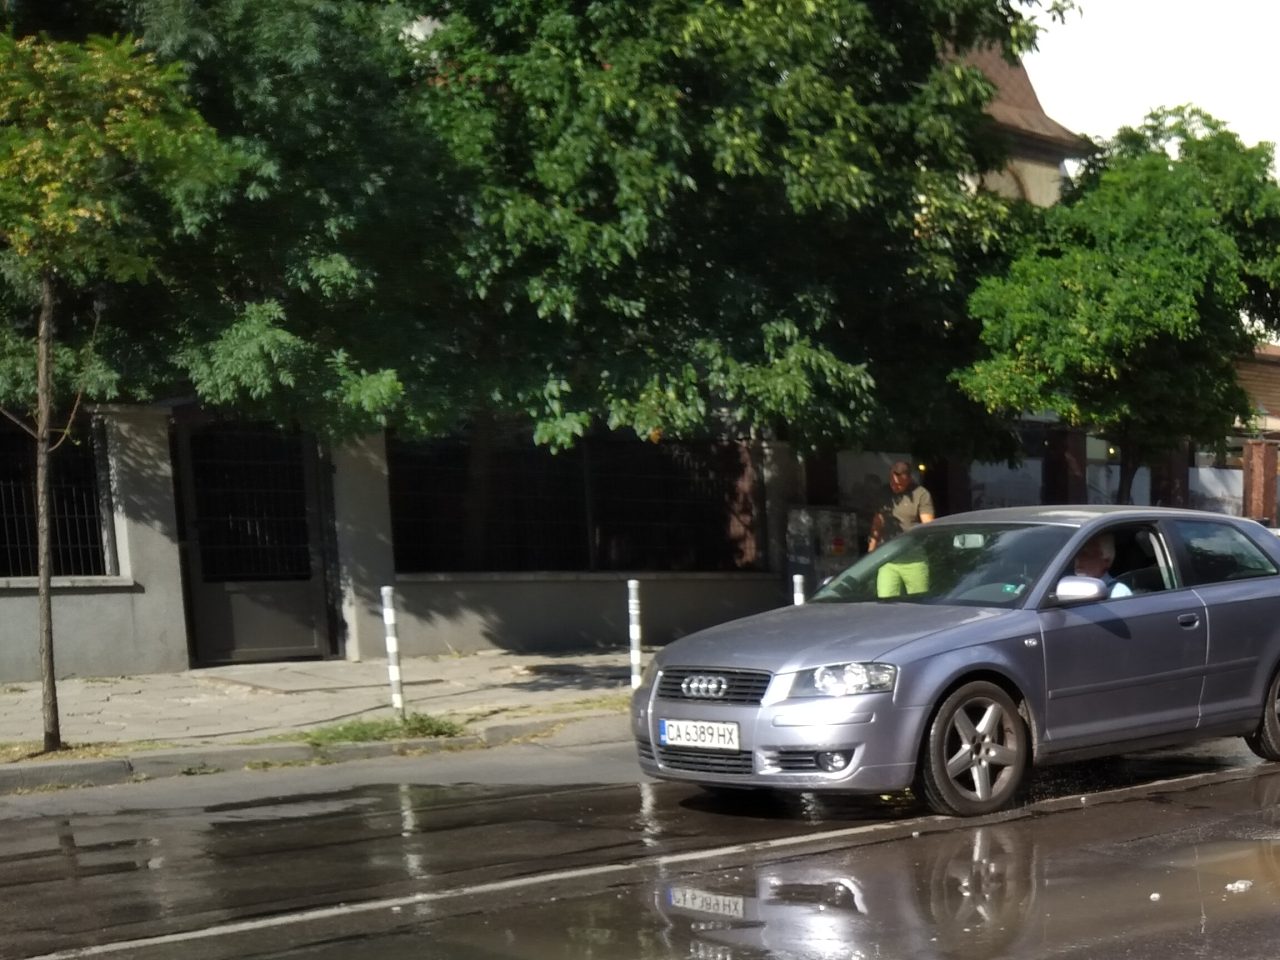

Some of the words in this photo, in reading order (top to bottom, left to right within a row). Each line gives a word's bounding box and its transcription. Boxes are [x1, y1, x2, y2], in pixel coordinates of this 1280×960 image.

[667, 724, 682, 742] CA
[685, 725, 715, 743] 6389
[717, 726, 735, 745] HX
